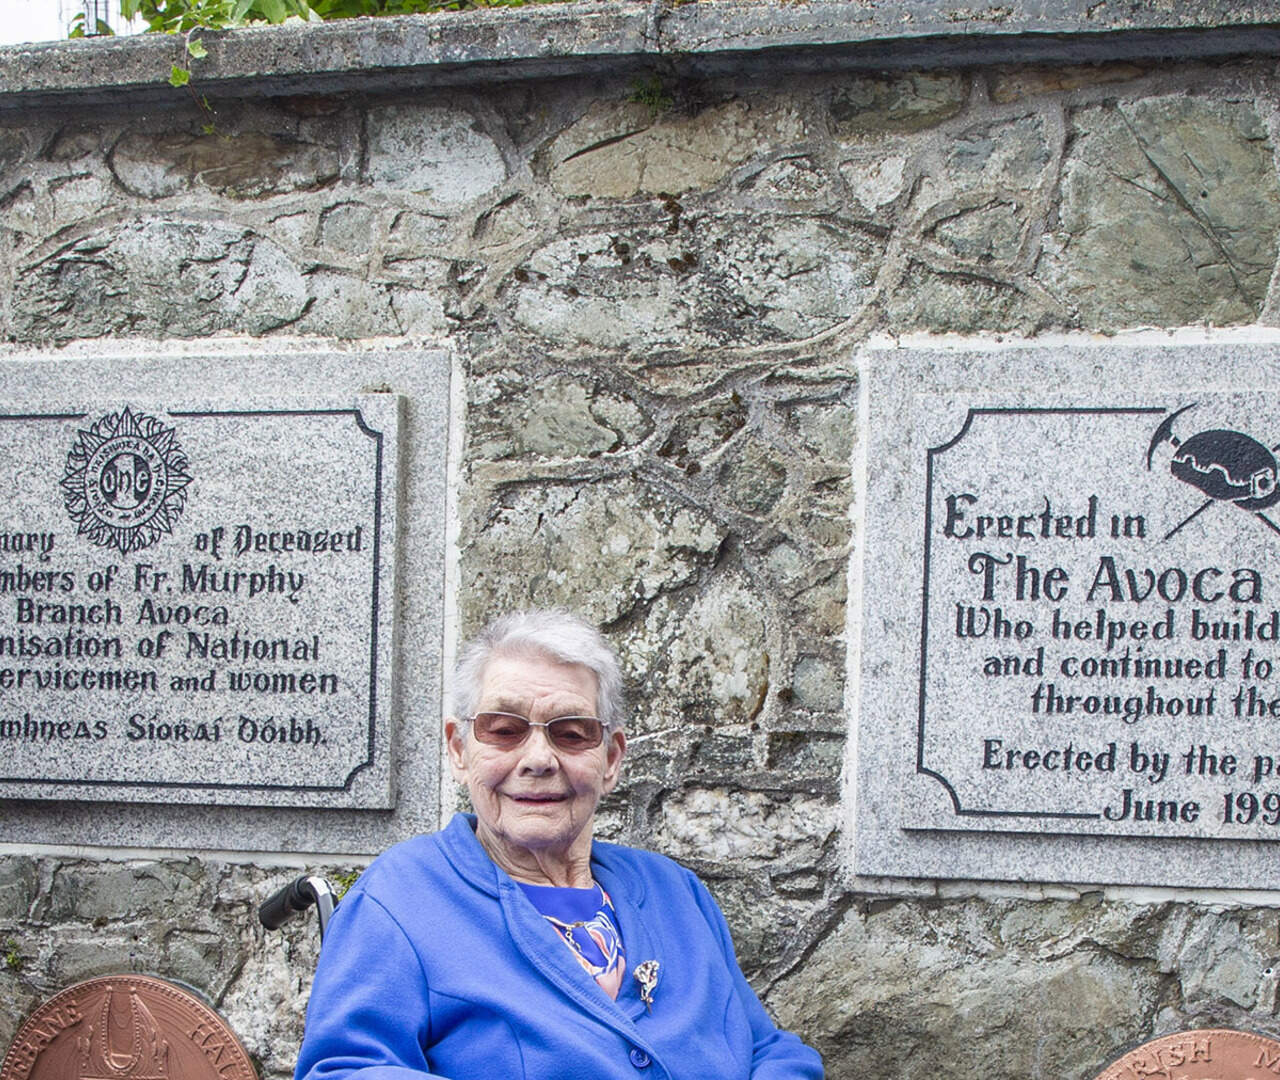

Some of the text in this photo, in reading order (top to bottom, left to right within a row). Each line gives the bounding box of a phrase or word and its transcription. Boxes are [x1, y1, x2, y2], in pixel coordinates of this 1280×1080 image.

[943, 493, 1099, 540] Erected
[1110, 514, 1147, 539] in
[194, 525, 224, 560] of
[88, 564, 118, 592] of
[134, 562, 172, 593] Fr.
[182, 563, 304, 604] Murphy
[968, 552, 1069, 602] The
[1086, 556, 1262, 603] Avoca
[17, 597, 229, 625] Branch Avoca
[956, 602, 1034, 640] Who
[1052, 608, 1174, 651] helped
[1191, 609, 1280, 642] build
[137, 629, 173, 658] of
[186, 629, 320, 663] National
[983, 647, 1045, 678] and
[1061, 647, 1227, 679] continued
[1242, 649, 1273, 681] to
[170, 670, 216, 692] and
[228, 671, 338, 694] women
[1030, 682, 1218, 725] throughout
[982, 739, 1117, 772] Erected
[1130, 741, 1170, 783] by
[1183, 744, 1237, 777] the
[1103, 789, 1201, 823] June
